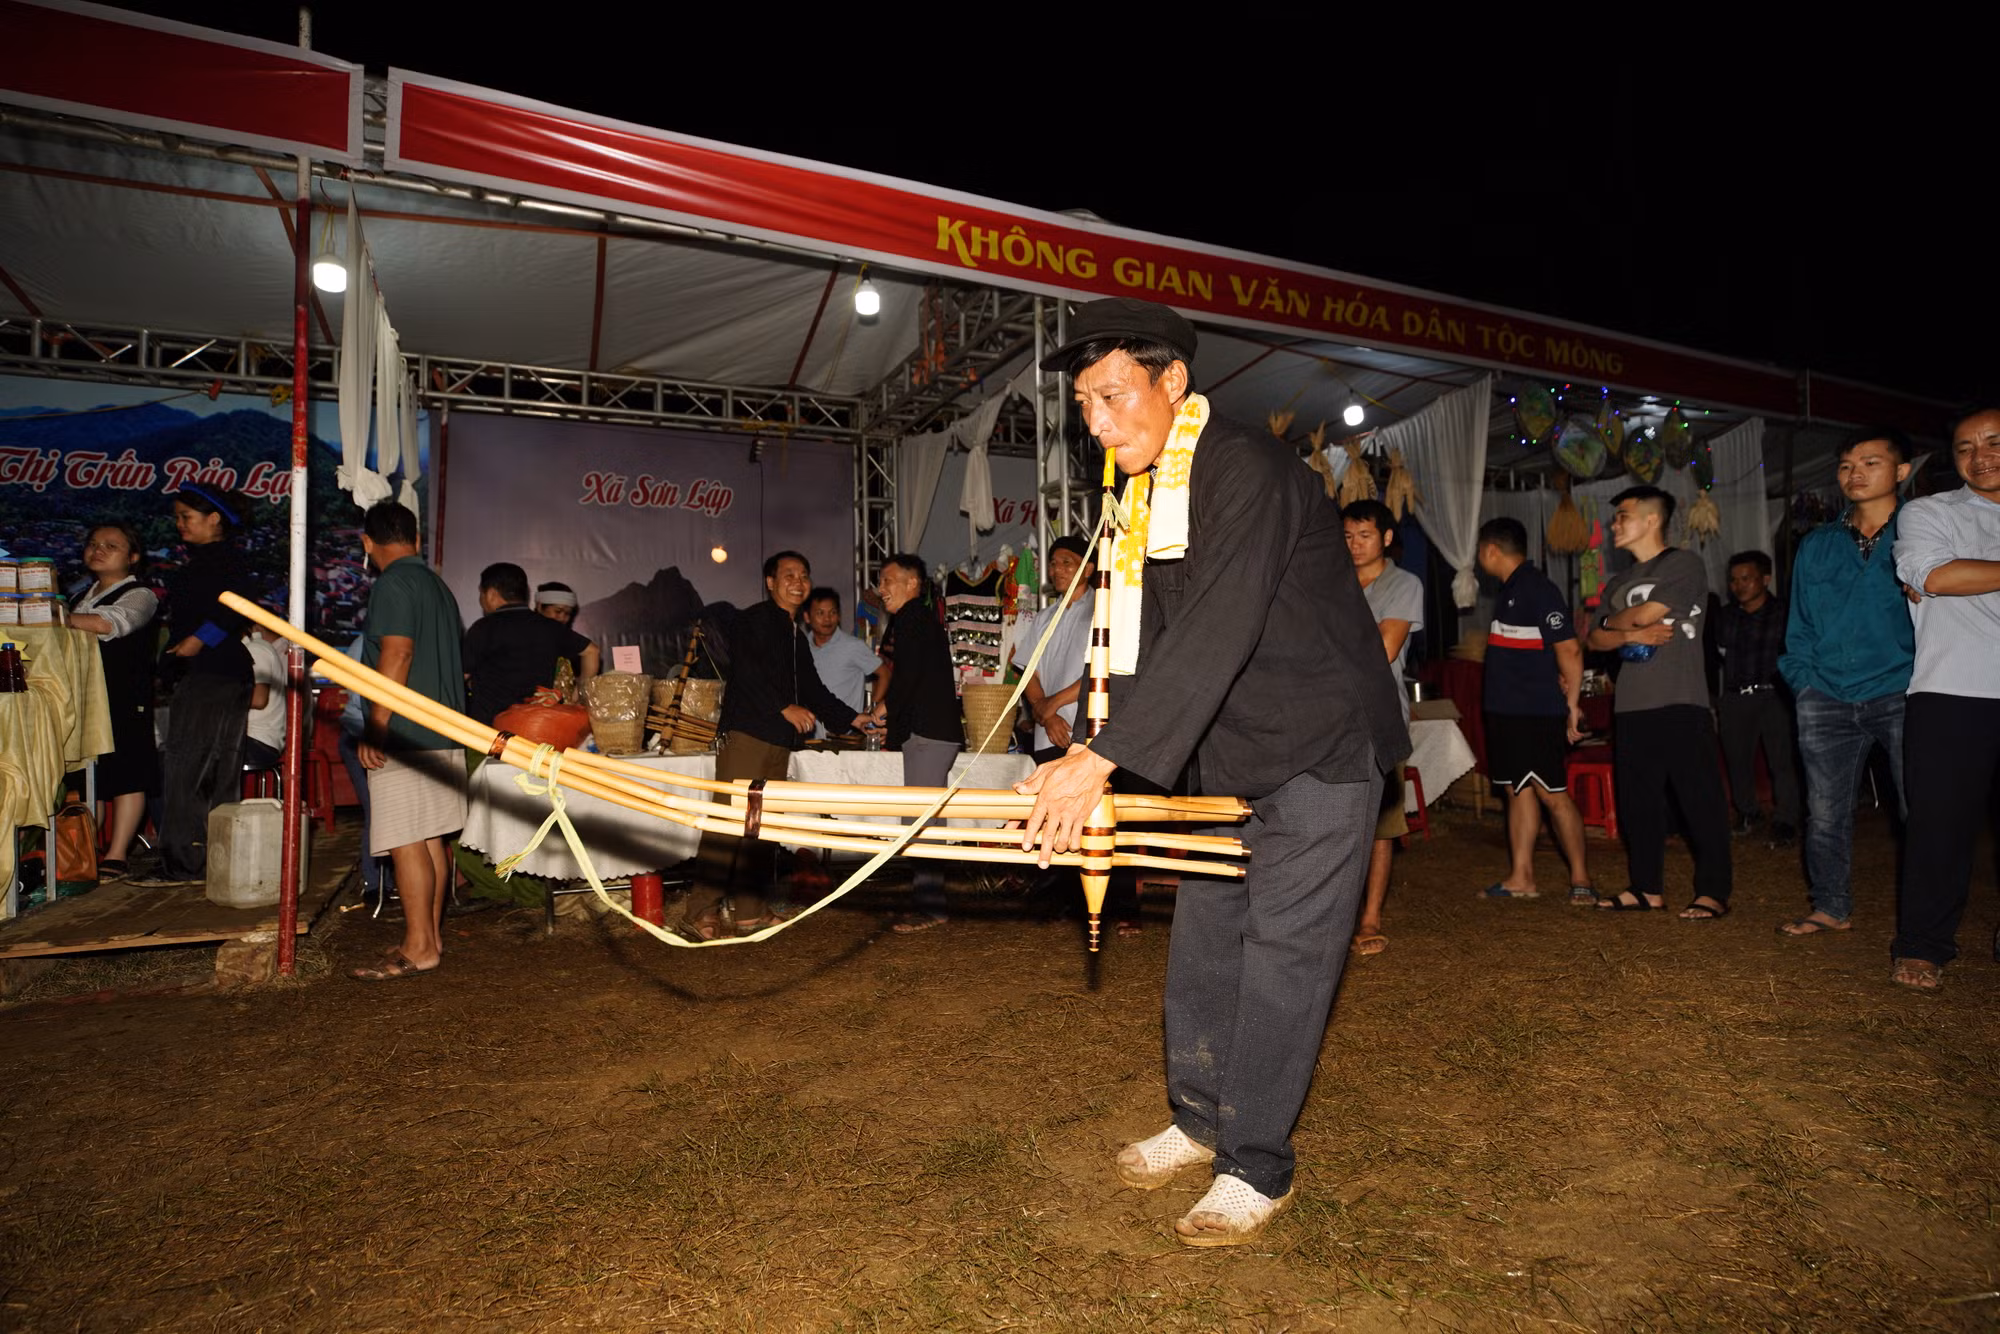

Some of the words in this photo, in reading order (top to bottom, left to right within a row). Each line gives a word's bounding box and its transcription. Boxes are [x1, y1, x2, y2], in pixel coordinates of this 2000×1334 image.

[936, 215, 1098, 279] KHÔNG
[1113, 257, 1213, 301] GIAN
[1229, 274, 1311, 319] VĂN
[1322, 291, 1392, 332] HÓA
[1402, 308, 1466, 346] DÂN
[1476, 323, 1535, 361] TỘC
[1545, 336, 1624, 375] MÔNG
[0, 446, 61, 492] Thị
[64, 449, 156, 490] Trấn
[161, 457, 237, 494] Bảo
[240, 461, 293, 503] Lạ
[580, 472, 627, 505] Xã
[630, 475, 680, 508] Sơn
[680, 478, 734, 517] Lập
